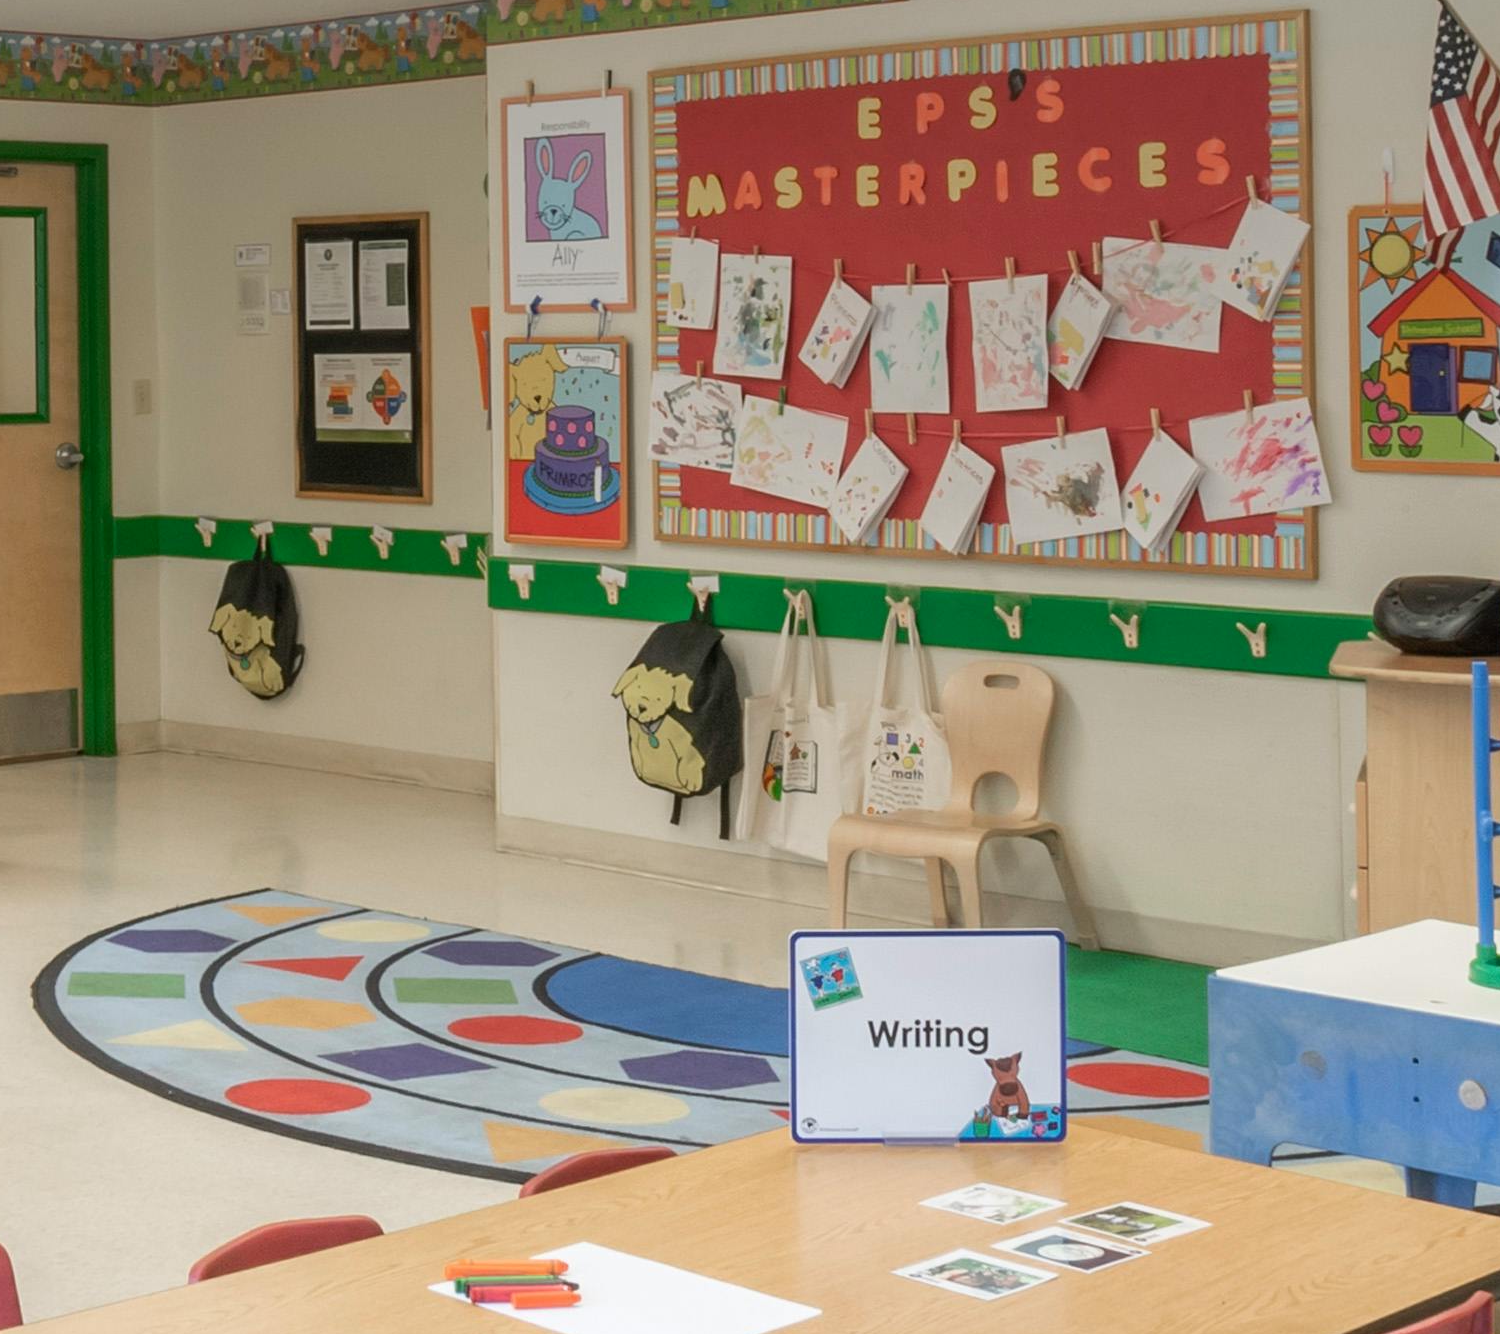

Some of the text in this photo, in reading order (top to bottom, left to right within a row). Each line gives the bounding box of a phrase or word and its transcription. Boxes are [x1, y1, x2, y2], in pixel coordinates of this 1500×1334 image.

[541, 121, 590, 132] Responsibility
[686, 137, 1231, 218] MASTERPIECES
[576, 351, 601, 365] August
[905, 733, 912, 744] 3
[891, 769, 924, 780] math
[867, 1019, 990, 1055] Writing
